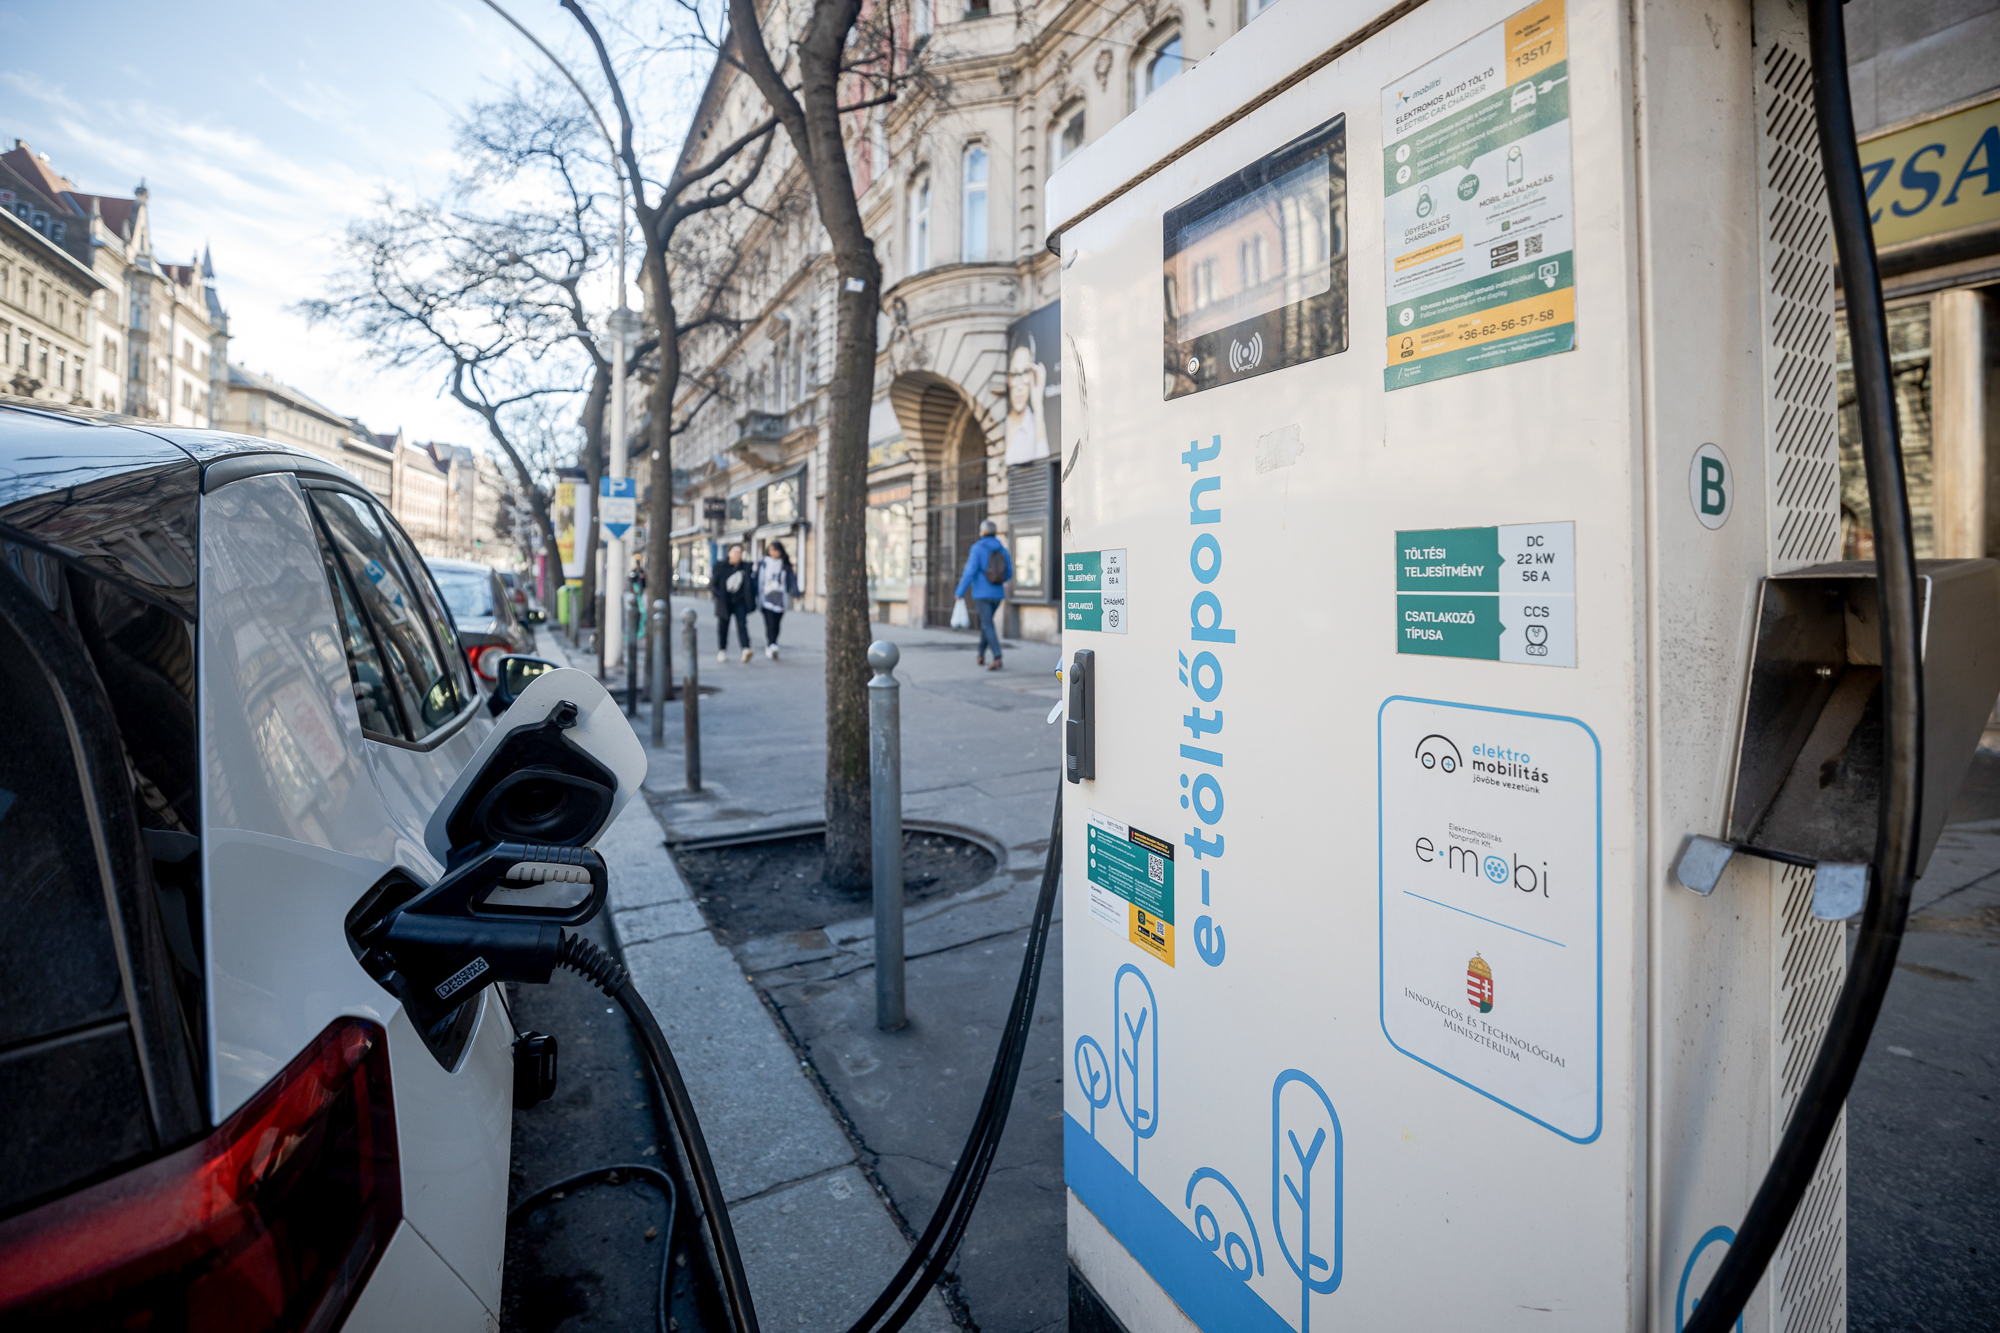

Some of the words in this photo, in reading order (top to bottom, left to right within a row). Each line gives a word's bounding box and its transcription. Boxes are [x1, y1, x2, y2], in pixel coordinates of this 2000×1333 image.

[1515, 40, 1551, 68] 13517
[1395, 93, 1443, 125] ELEKTROMOS
[1445, 80, 1466, 99] AUTÓ
[1468, 65, 1494, 87] TÖLTŐ
[1396, 111, 1428, 135] ELECTRIC
[1430, 102, 1446, 117] CAR
[1448, 82, 1485, 108] CHARGER
[1400, 168, 1406, 179] 2
[1460, 178, 1476, 191] VAGY
[1463, 187, 1473, 196] OR
[1479, 193, 1500, 209] MOBIL
[1503, 172, 1553, 199] ALKALMAZÁS
[1493, 194, 1521, 212] MOBILE
[1523, 187, 1538, 200] APP
[1404, 213, 1450, 237] ÜGYFÉLKULCS
[1404, 226, 1436, 245] CHARGING
[1437, 221, 1450, 232] KEY
[1404, 312, 1409, 321] 3
[1420, 309, 1436, 319] Follow
[1458, 308, 1554, 342] +36-62-56-57-58
[1702, 455, 1726, 516] B
[1527, 536, 1544, 547] DC
[1404, 546, 1446, 560] TÖLTÉSI
[1517, 554, 1533, 565] 22
[1536, 552, 1555, 564] kW
[1068, 562, 1084, 571] TÖLTÉSI
[1404, 564, 1484, 578] TELJESÍTMÉNY
[1068, 573, 1096, 582] TELJESÍTMÉNY
[1522, 571, 1538, 582] 56
[1542, 571, 1550, 582] A
[1405, 610, 1476, 624] CSATLAKOZÓ
[1524, 606, 1550, 618] CCS
[1405, 626, 1444, 640] TÍPUSA
[1179, 434, 1236, 968] e-töltőpont
[1472, 743, 1530, 764] elektro
[1472, 760, 1549, 784] mobilitás
[1502, 780, 1540, 794] vezetünk
[1449, 822, 1502, 842] Elektromobilitás
[1449, 831, 1480, 845] Nonprofit
[452, 962, 487, 990] CONTACT
[1404, 987, 1463, 1021] INNOVÁCIÓS
[1467, 1015, 1477, 1028] ÉS
[1480, 1020, 1565, 1068] TECHNOLÓGIAI
[1444, 1018, 1520, 1062] MINISZTÉRIUM
